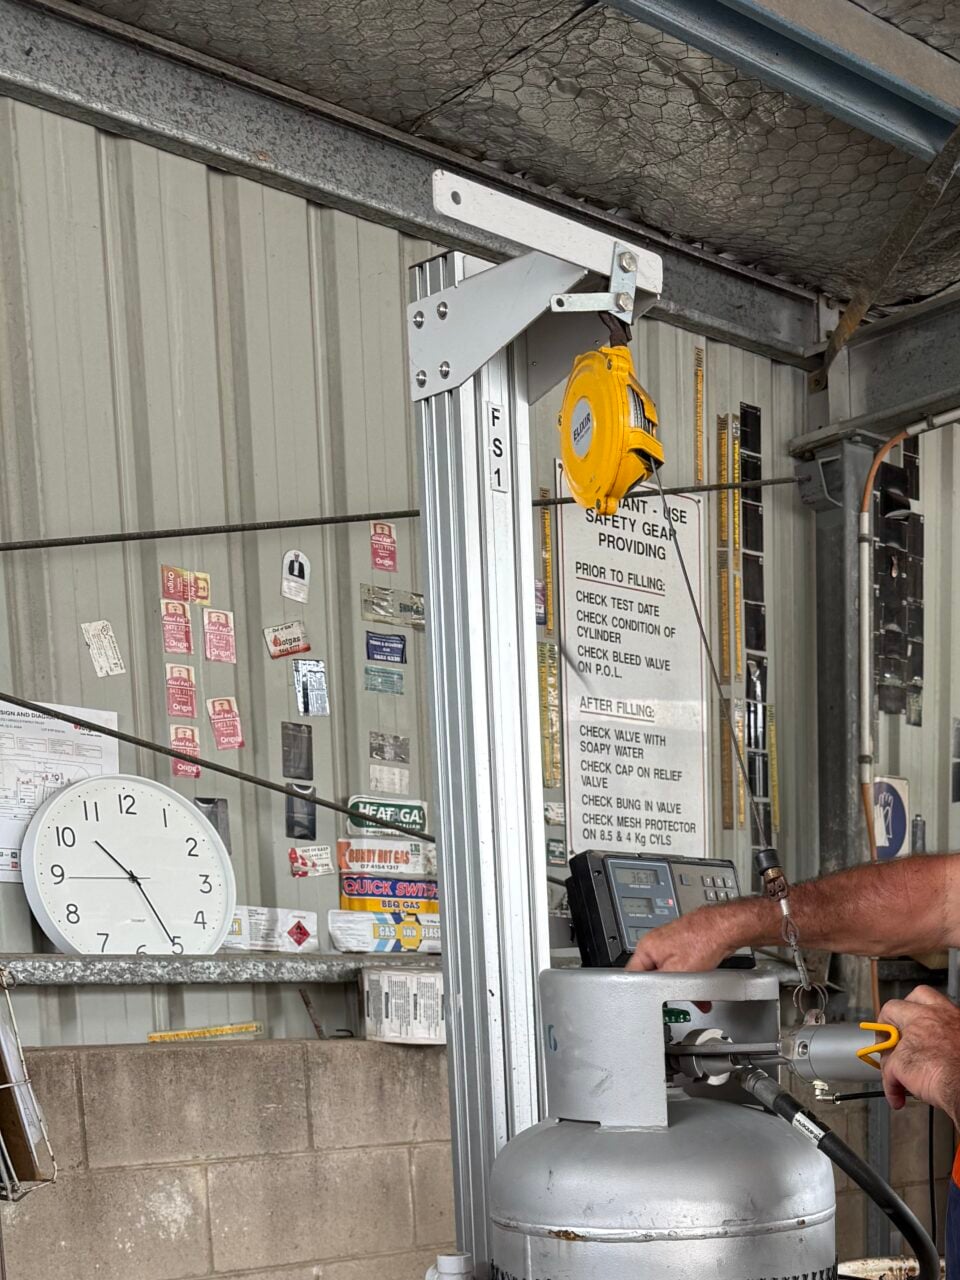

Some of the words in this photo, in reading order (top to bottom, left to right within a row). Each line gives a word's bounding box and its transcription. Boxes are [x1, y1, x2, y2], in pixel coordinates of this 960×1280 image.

[573, 412, 591, 441] ELIXIR
[585, 508, 636, 532] SAFETY
[642, 522, 676, 541] GEAR
[663, 505, 687, 524] USE
[598, 532, 666, 560] PROVIDING
[575, 561, 606, 580] PRIOR
[610, 569, 624, 583] TO
[628, 572, 666, 592] FILLING:
[576, 590, 607, 607] CHECK
[611, 597, 633, 612] TEST
[638, 602, 660, 617] DATE
[576, 609, 608, 627] CHECK
[612, 617, 661, 636] CONDITION
[664, 627, 676, 639] OF
[577, 626, 622, 644] CYLINDER
[577, 645, 609, 661] CHECK
[613, 651, 641, 666] BLEED
[645, 657, 671, 671] VALVE
[577, 661, 592, 673] ON
[596, 666, 623, 679] P.O.L.
[580, 696, 612, 713] AFTER
[617, 701, 655, 718] FILLING:
[580, 725, 611, 740] CHECK
[614, 729, 640, 743] VALVE
[644, 733, 666, 747] WITH
[580, 741, 610, 755] SOAPY
[614, 745, 644, 759] WATER
[581, 760, 612, 774] CHECK
[615, 764, 634, 776] CAP
[637, 766, 650, 778] ON
[653, 768, 682, 782] RELIEF
[581, 775, 608, 789] VALVE
[83, 800, 99, 822] 11
[118, 794, 137, 815] 12
[581, 794, 613, 808] CHECK
[616, 798, 641, 811] BUNG
[644, 800, 653, 811] IN
[656, 801, 682, 815] VALVE
[162, 808, 167, 828] 1
[582, 813, 613, 827] CHECK
[616, 817, 642, 829] MESH
[645, 819, 696, 834] PROTECTOR
[56, 826, 76, 848] 10
[185, 837, 199, 857] 2
[582, 828, 596, 840] ON
[600, 830, 613, 842] 8.5
[616, 831, 623, 842] &
[626, 832, 631, 841] 4
[635, 833, 646, 846] Kg
[649, 834, 672, 846] CYLS
[349, 849, 376, 863] BUNDY
[377, 849, 393, 864] HOT
[394, 850, 410, 865] GAS
[50, 864, 65, 885] 9
[199, 874, 213, 894] 3
[343, 879, 392, 896] QUICK
[66, 903, 80, 924] 8
[382, 900, 400, 909] BBQ
[402, 901, 420, 909] GAS
[193, 910, 207, 930] 4
[379, 926, 395, 937] GAS
[96, 933, 109, 953] 7
[171, 936, 184, 955] 5
